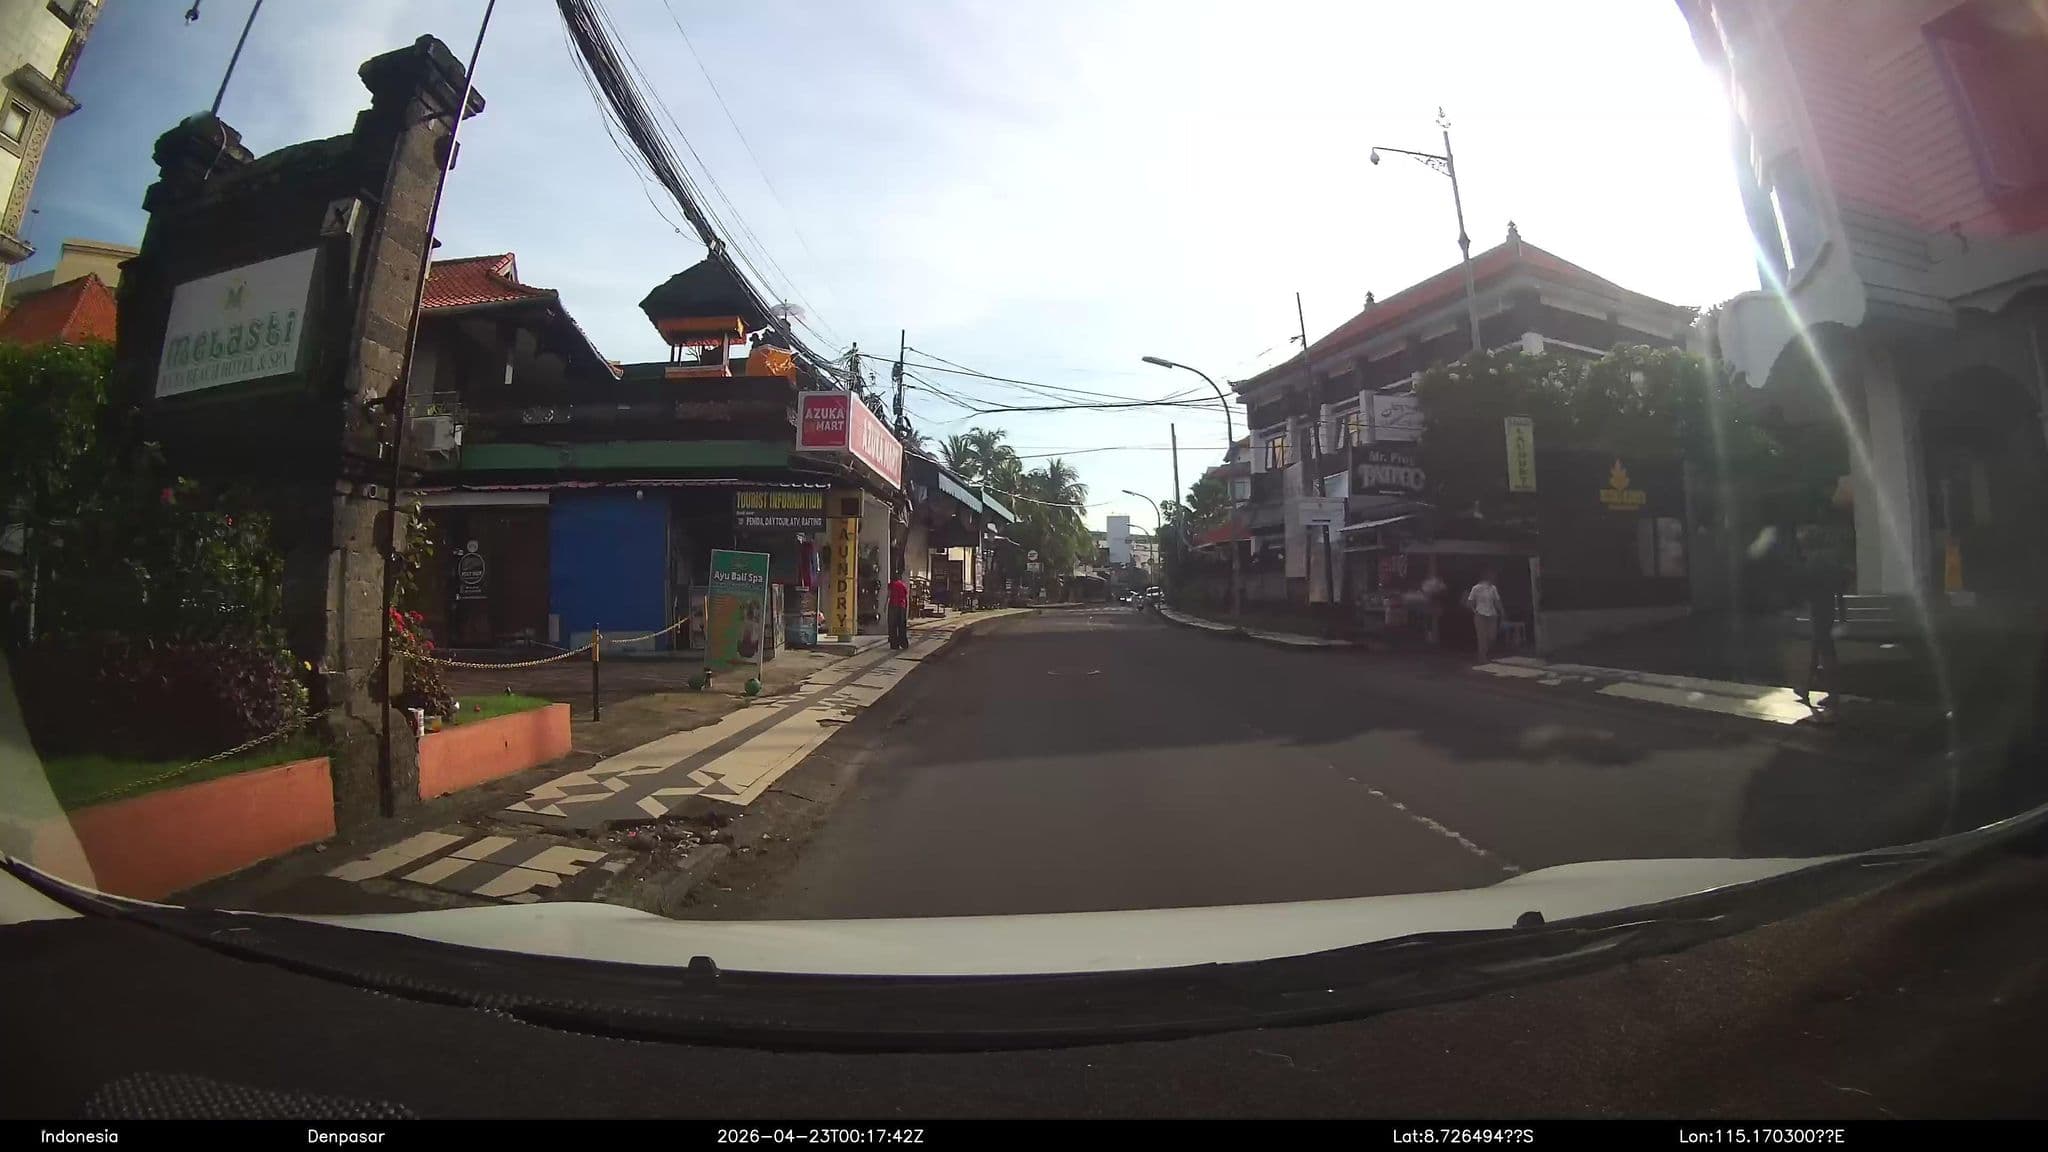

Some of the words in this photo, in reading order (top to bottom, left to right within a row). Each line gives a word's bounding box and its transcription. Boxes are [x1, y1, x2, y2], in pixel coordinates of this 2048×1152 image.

[805, 407, 845, 419] AZUKA
[816, 421, 844, 431] MART
[737, 491, 769, 509] TOURIST
[769, 490, 822, 509] INFORMATION
[713, 571, 730, 582] Ayu
[731, 572, 747, 581] Bali
[748, 573, 763, 584] Spa
